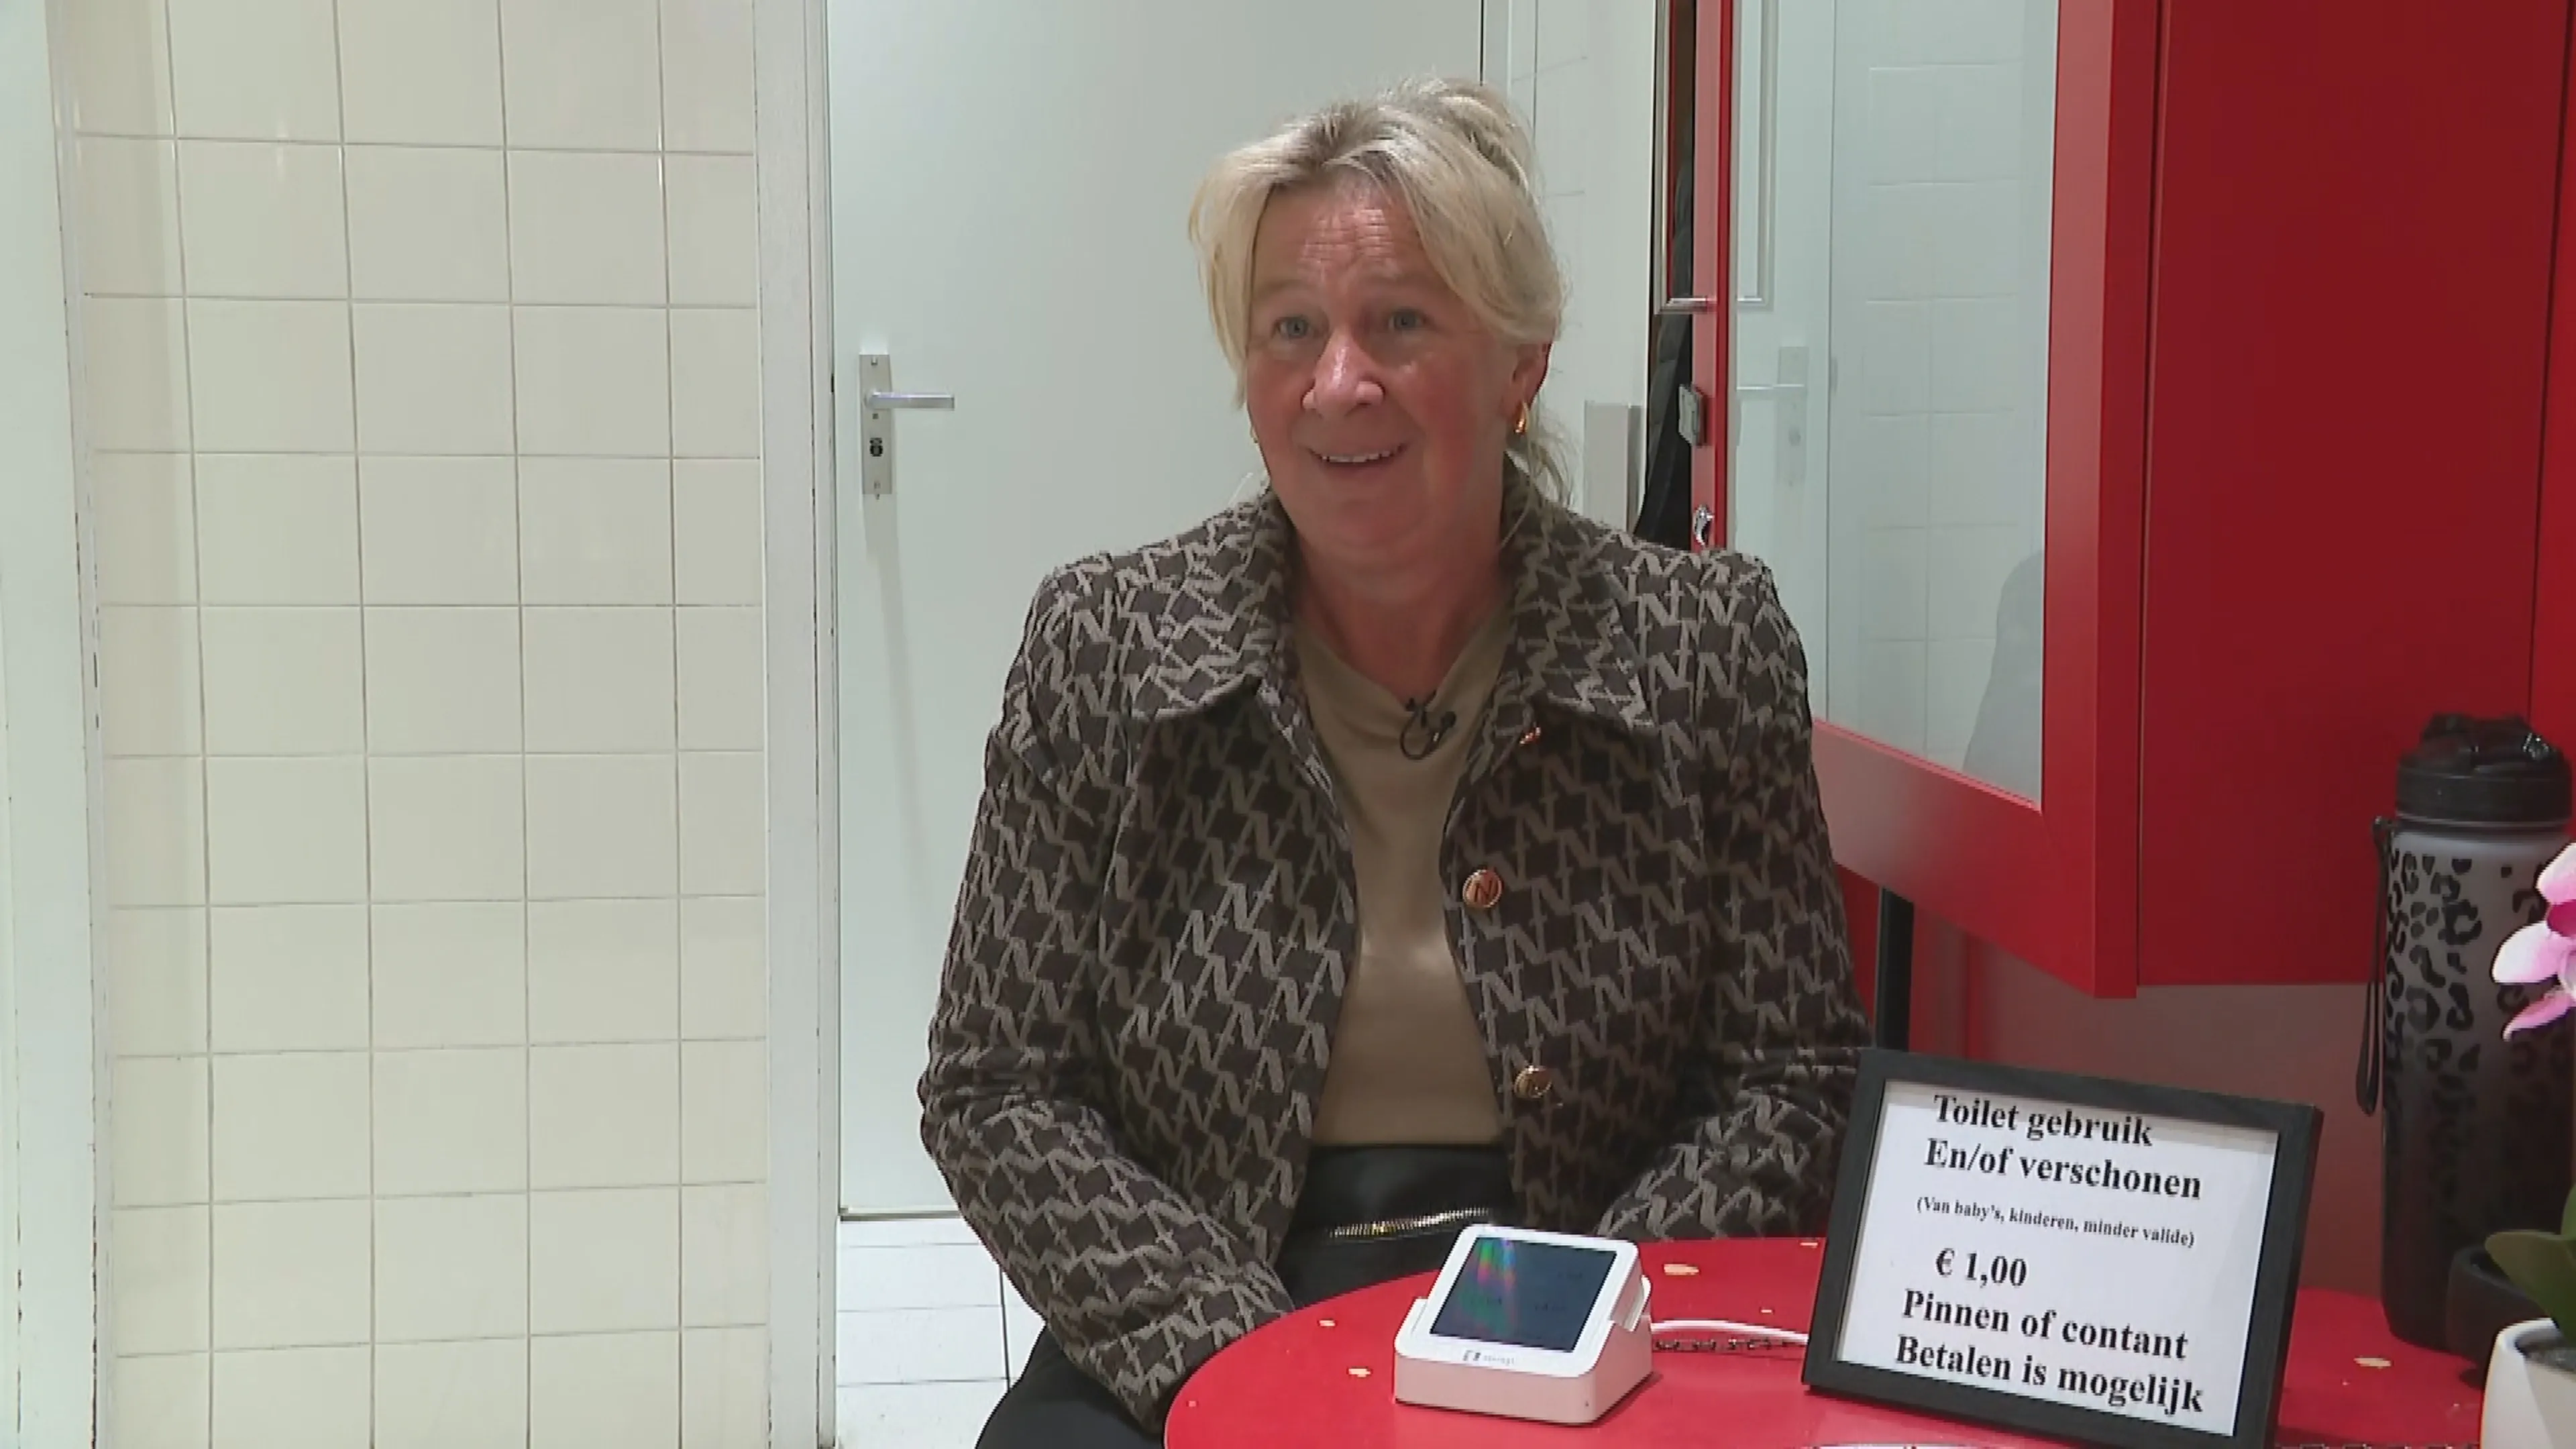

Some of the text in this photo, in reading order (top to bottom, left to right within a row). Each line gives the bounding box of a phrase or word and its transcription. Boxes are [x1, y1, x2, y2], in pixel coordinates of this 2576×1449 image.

[1933, 1093, 2153, 1146] Toilet gebruik
[1924, 1138, 2201, 1199] En/of verschonen
[1917, 1196, 2194, 1248] (Van baby's, kinderen, minder valide)
[1935, 1248, 2027, 1287] € 1,00
[1903, 1288, 2188, 1360] Pinnen of contant
[1896, 1336, 2203, 1416] Betalen is mogelijk
